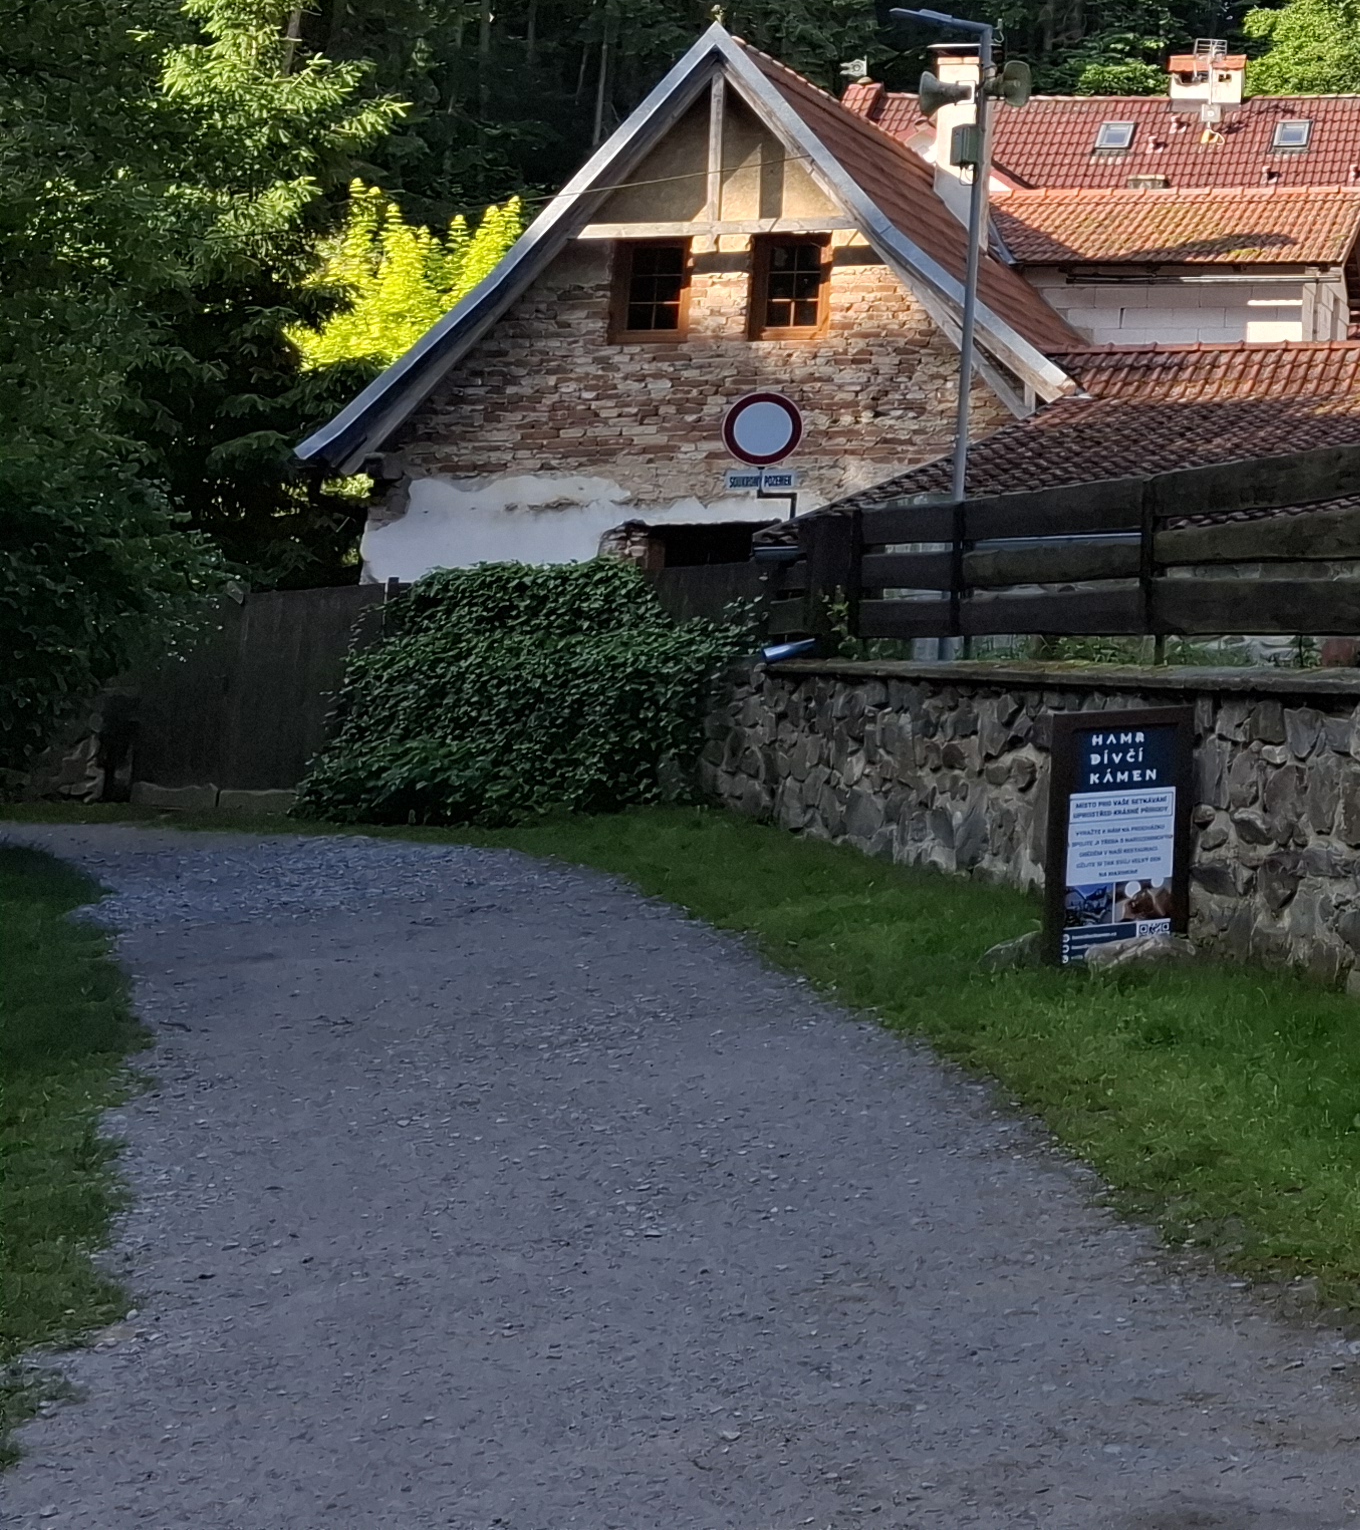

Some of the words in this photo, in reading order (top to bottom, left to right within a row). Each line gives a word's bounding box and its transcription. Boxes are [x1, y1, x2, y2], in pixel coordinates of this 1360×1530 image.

[1091, 732, 1145, 746] HAMR
[1090, 747, 1144, 765] DÍVČÍ
[1089, 768, 1157, 785] KÁMEN
